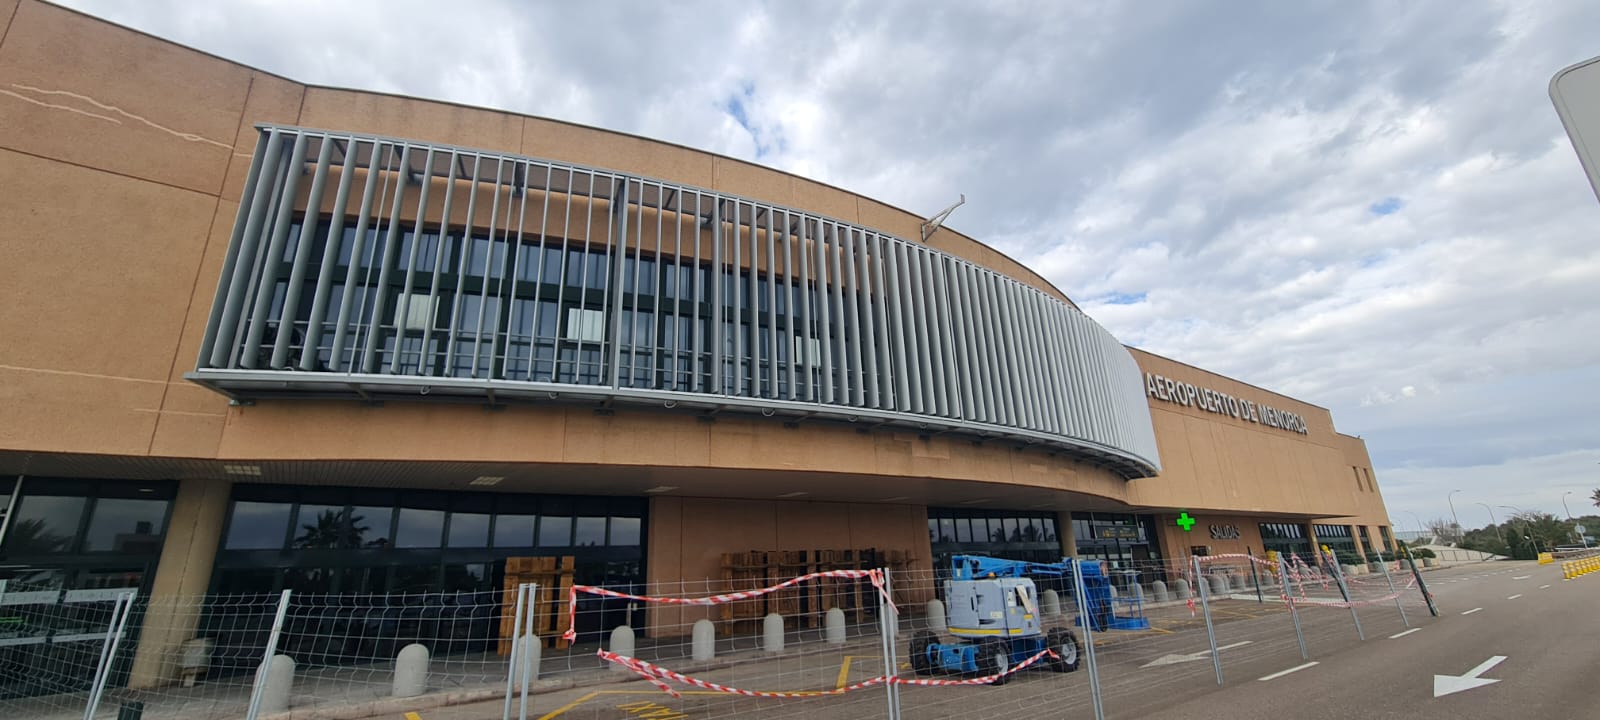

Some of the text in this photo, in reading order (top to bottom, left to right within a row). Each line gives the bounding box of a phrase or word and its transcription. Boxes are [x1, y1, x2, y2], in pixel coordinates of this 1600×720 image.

[1145, 372, 1309, 436] AEROPUERTO DE MENORCA
[1209, 524, 1240, 540] SALIDAS
